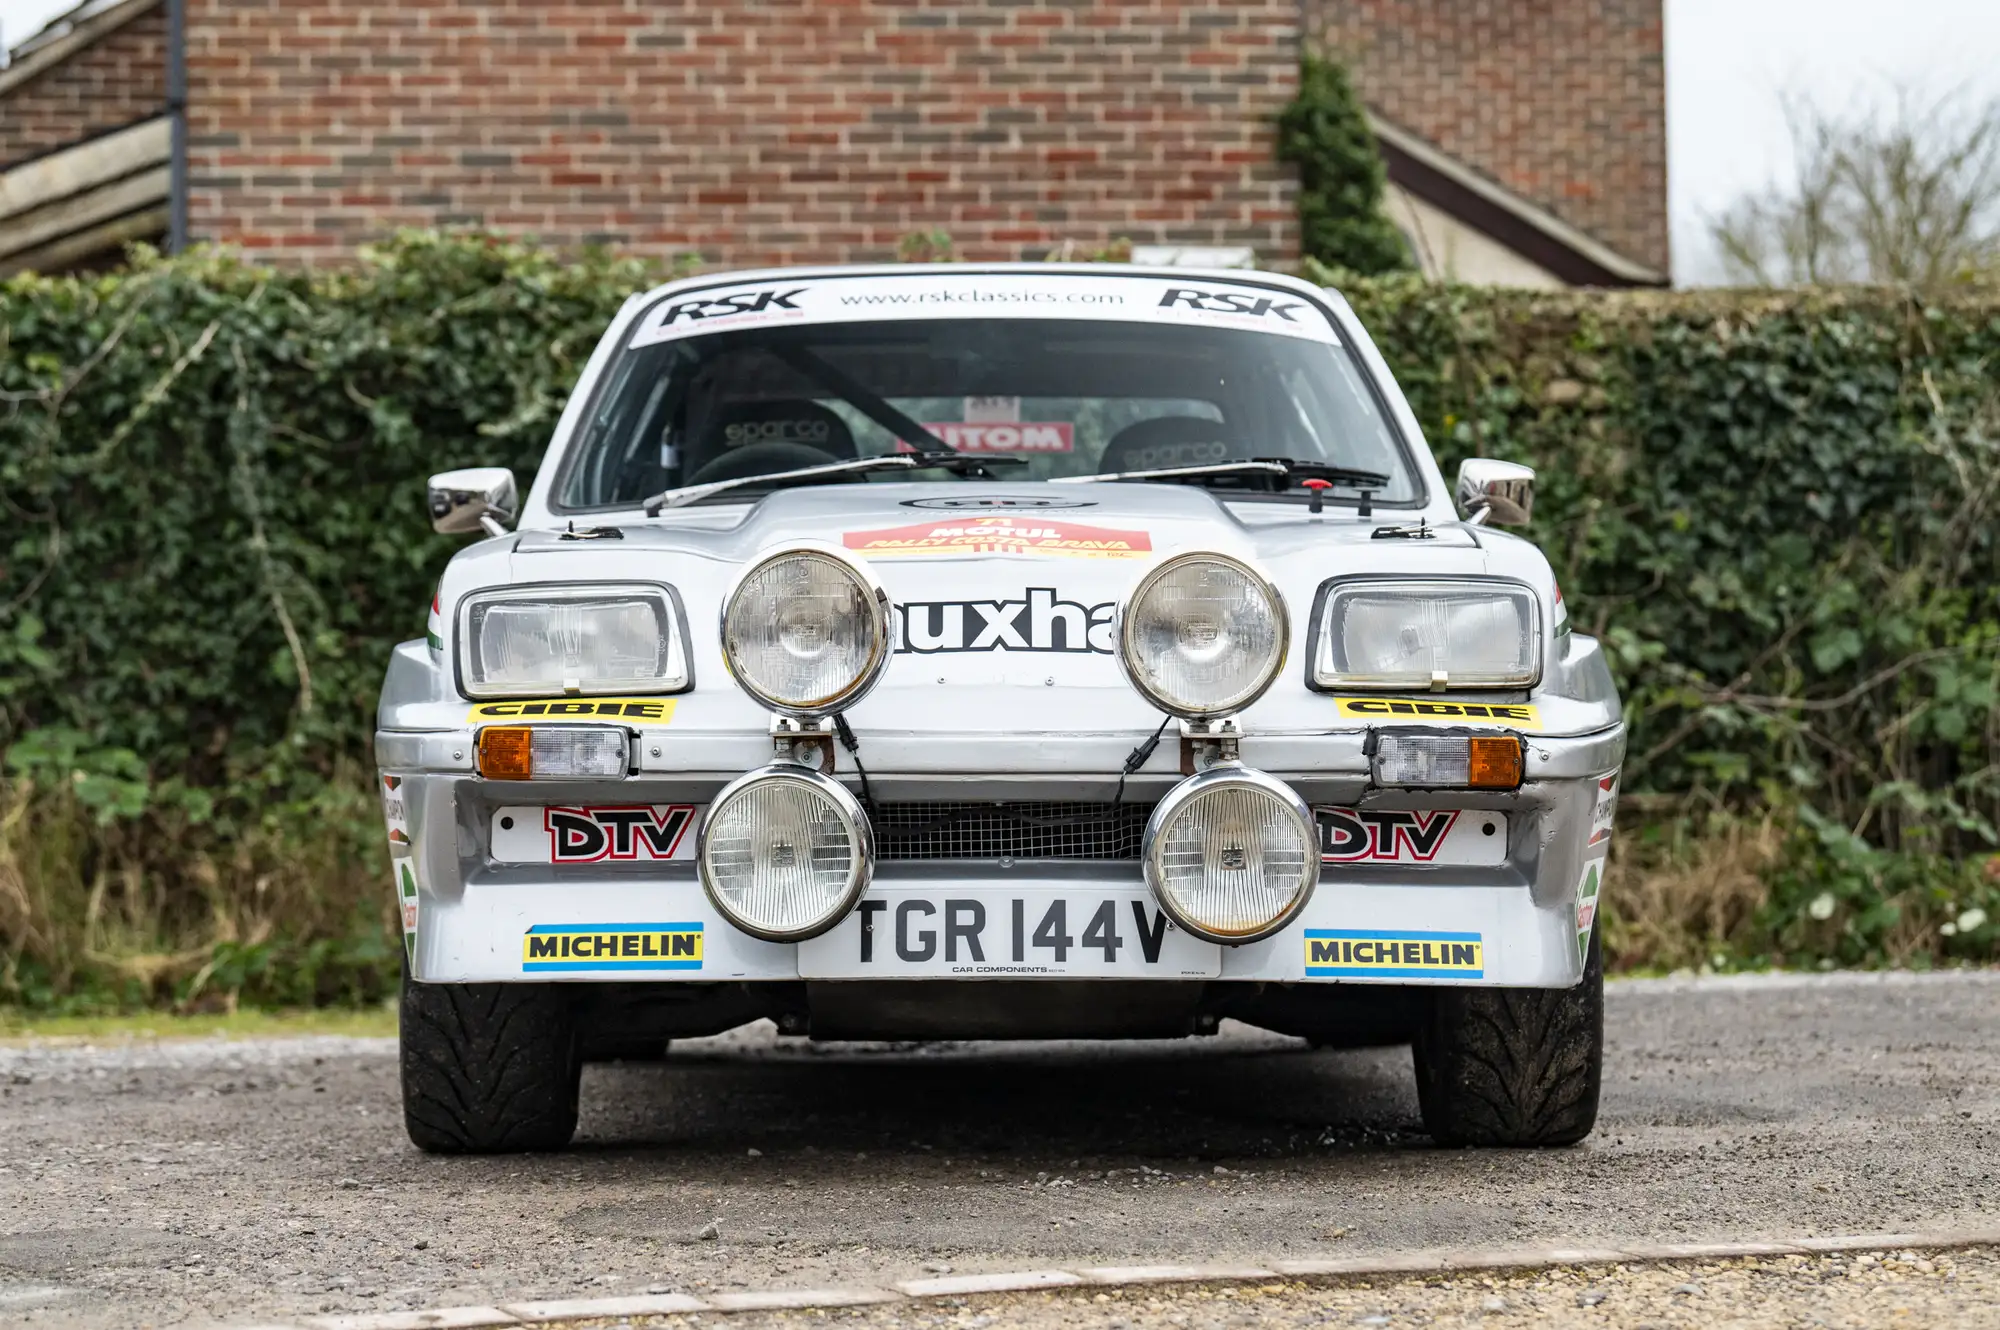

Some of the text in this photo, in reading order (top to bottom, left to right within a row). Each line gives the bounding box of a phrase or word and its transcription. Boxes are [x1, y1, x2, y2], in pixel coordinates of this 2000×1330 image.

[659, 287, 810, 327] RSK
[841, 289, 1124, 305] www.rskclassics.com
[1158, 288, 1305, 322] RSK
[725, 420, 829, 446] sparco
[864, 535, 1131, 550] RALLY COSTA BRAVA
[928, 526, 1061, 538] MOTUL
[1347, 701, 1531, 721] CIBIE
[547, 807, 692, 860] DTV
[1313, 805, 1458, 860] DTV
[855, 899, 1168, 964] TGR 144V
